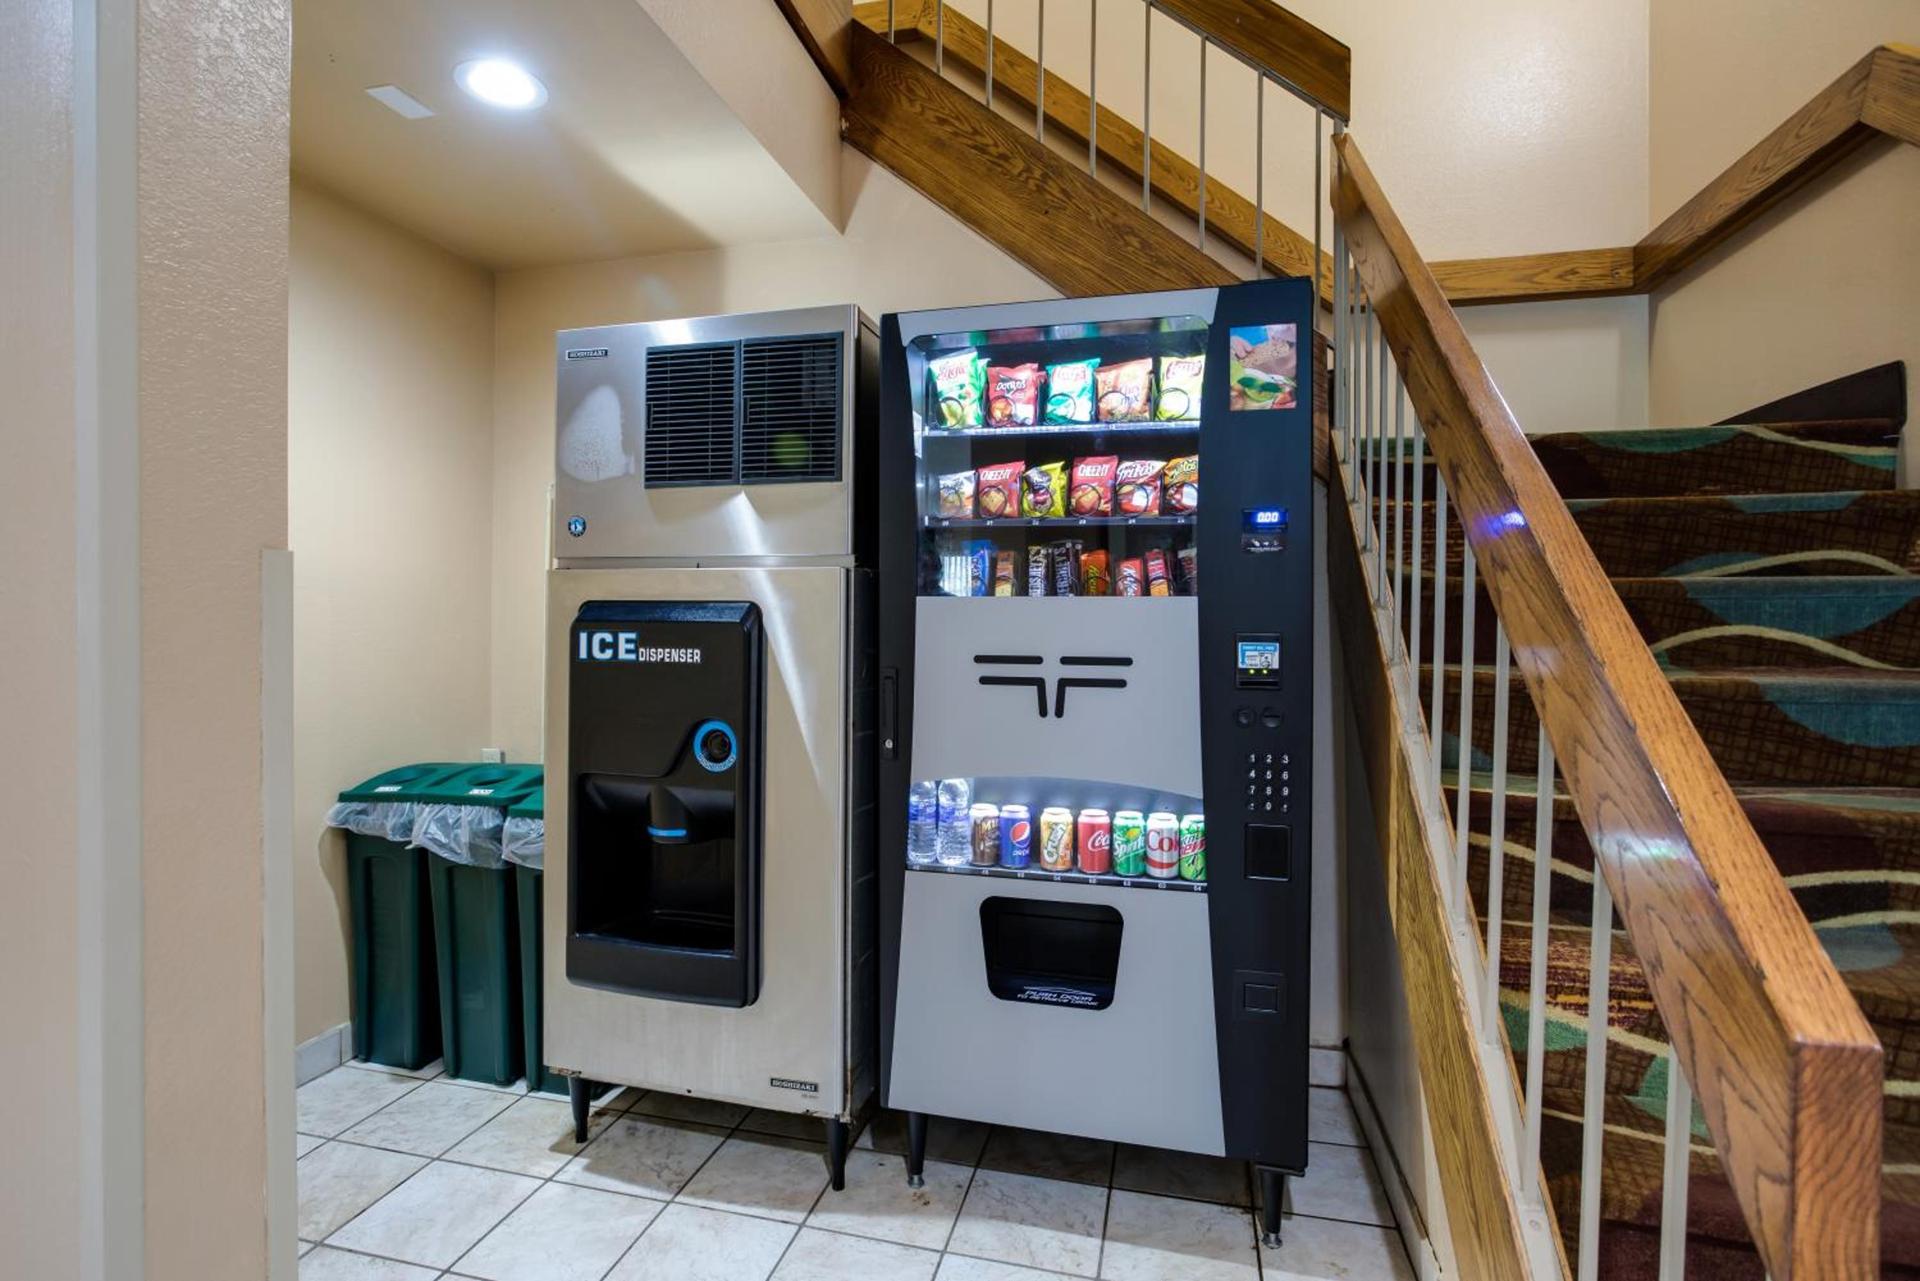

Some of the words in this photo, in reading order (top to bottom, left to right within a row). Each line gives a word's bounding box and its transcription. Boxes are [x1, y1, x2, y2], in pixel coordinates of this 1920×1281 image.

[996, 380, 1026, 391] Doritos
[579, 632, 637, 660] ICE
[639, 648, 701, 663] DISPENSER
[1250, 754, 1255, 762] 1
[1266, 755, 1272, 763] 2
[1282, 755, 1289, 763] 3
[1249, 770, 1255, 778] 4
[1266, 770, 1272, 779] 5
[1282, 771, 1288, 780] 6
[1250, 785, 1255, 794] 7
[1266, 786, 1272, 795] 8
[1282, 787, 1288, 796] 9
[1265, 802, 1271, 810] 0
